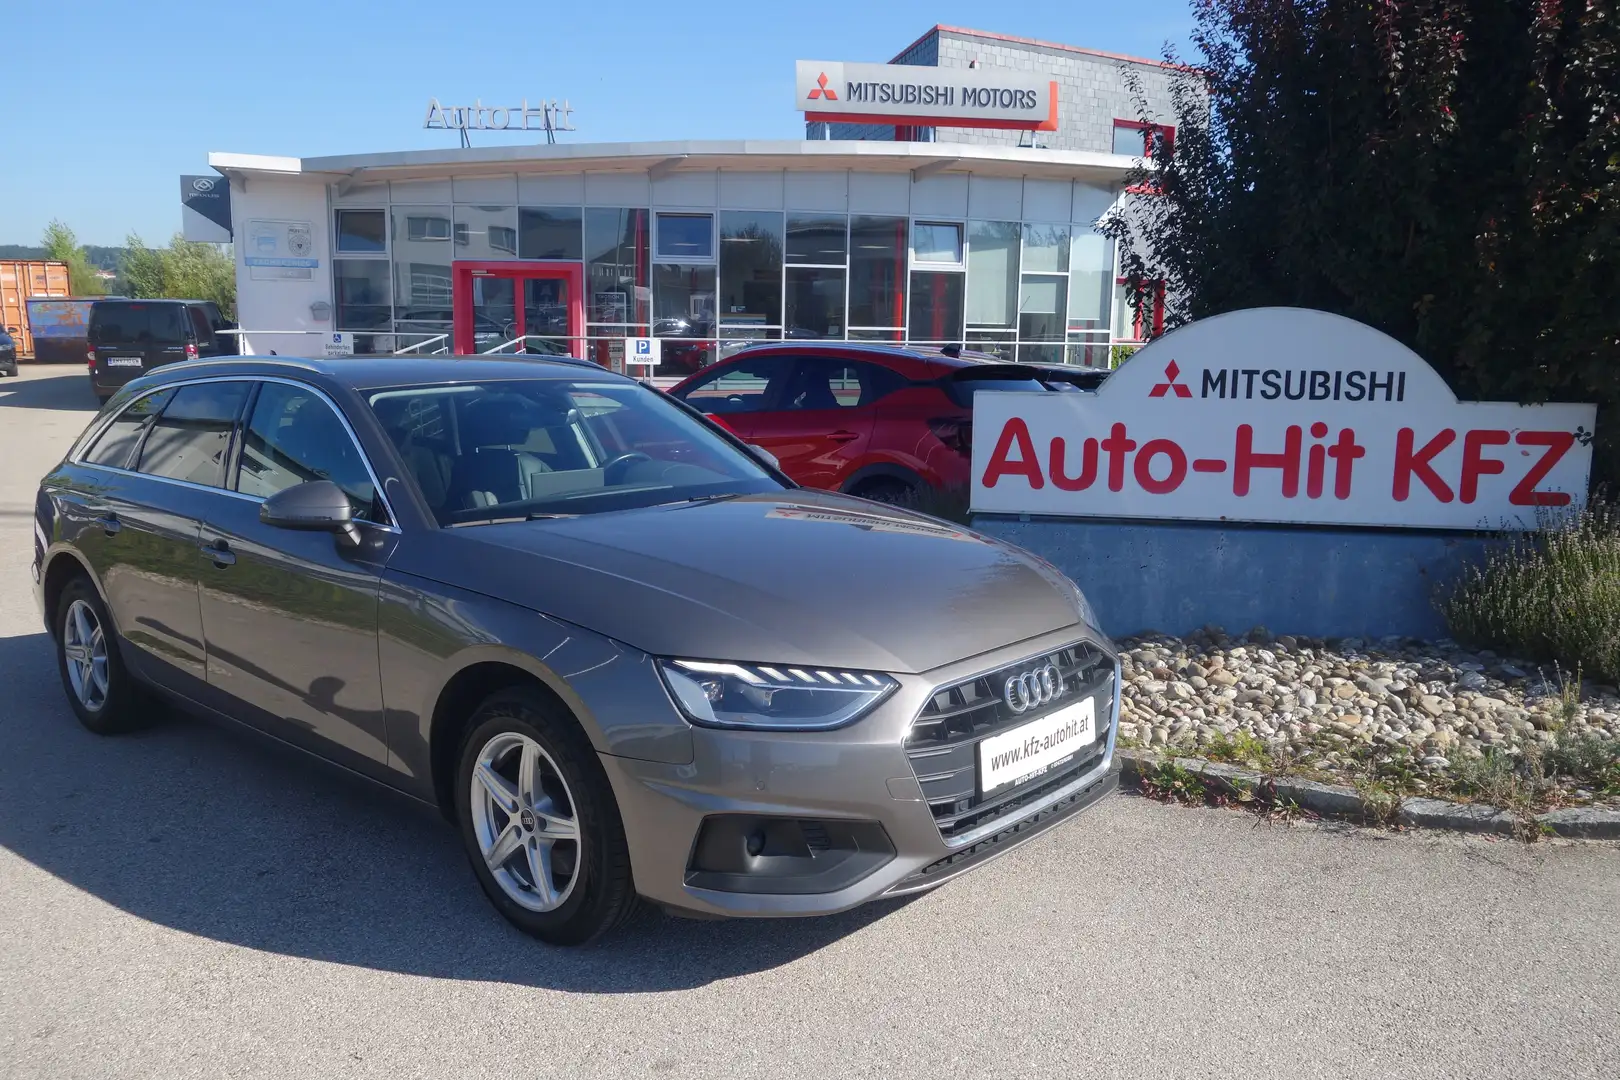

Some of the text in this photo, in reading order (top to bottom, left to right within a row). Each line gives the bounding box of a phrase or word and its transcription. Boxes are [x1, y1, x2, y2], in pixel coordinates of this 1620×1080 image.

[846, 82, 1037, 109] MITSUBISHI MOTORS
[423, 96, 576, 131] Auto Hit
[1201, 368, 1407, 402] MITSUBISHI
[981, 416, 1577, 506] Auto-Hit KFZ
[991, 714, 1089, 773] www.kfz-autohit.at
